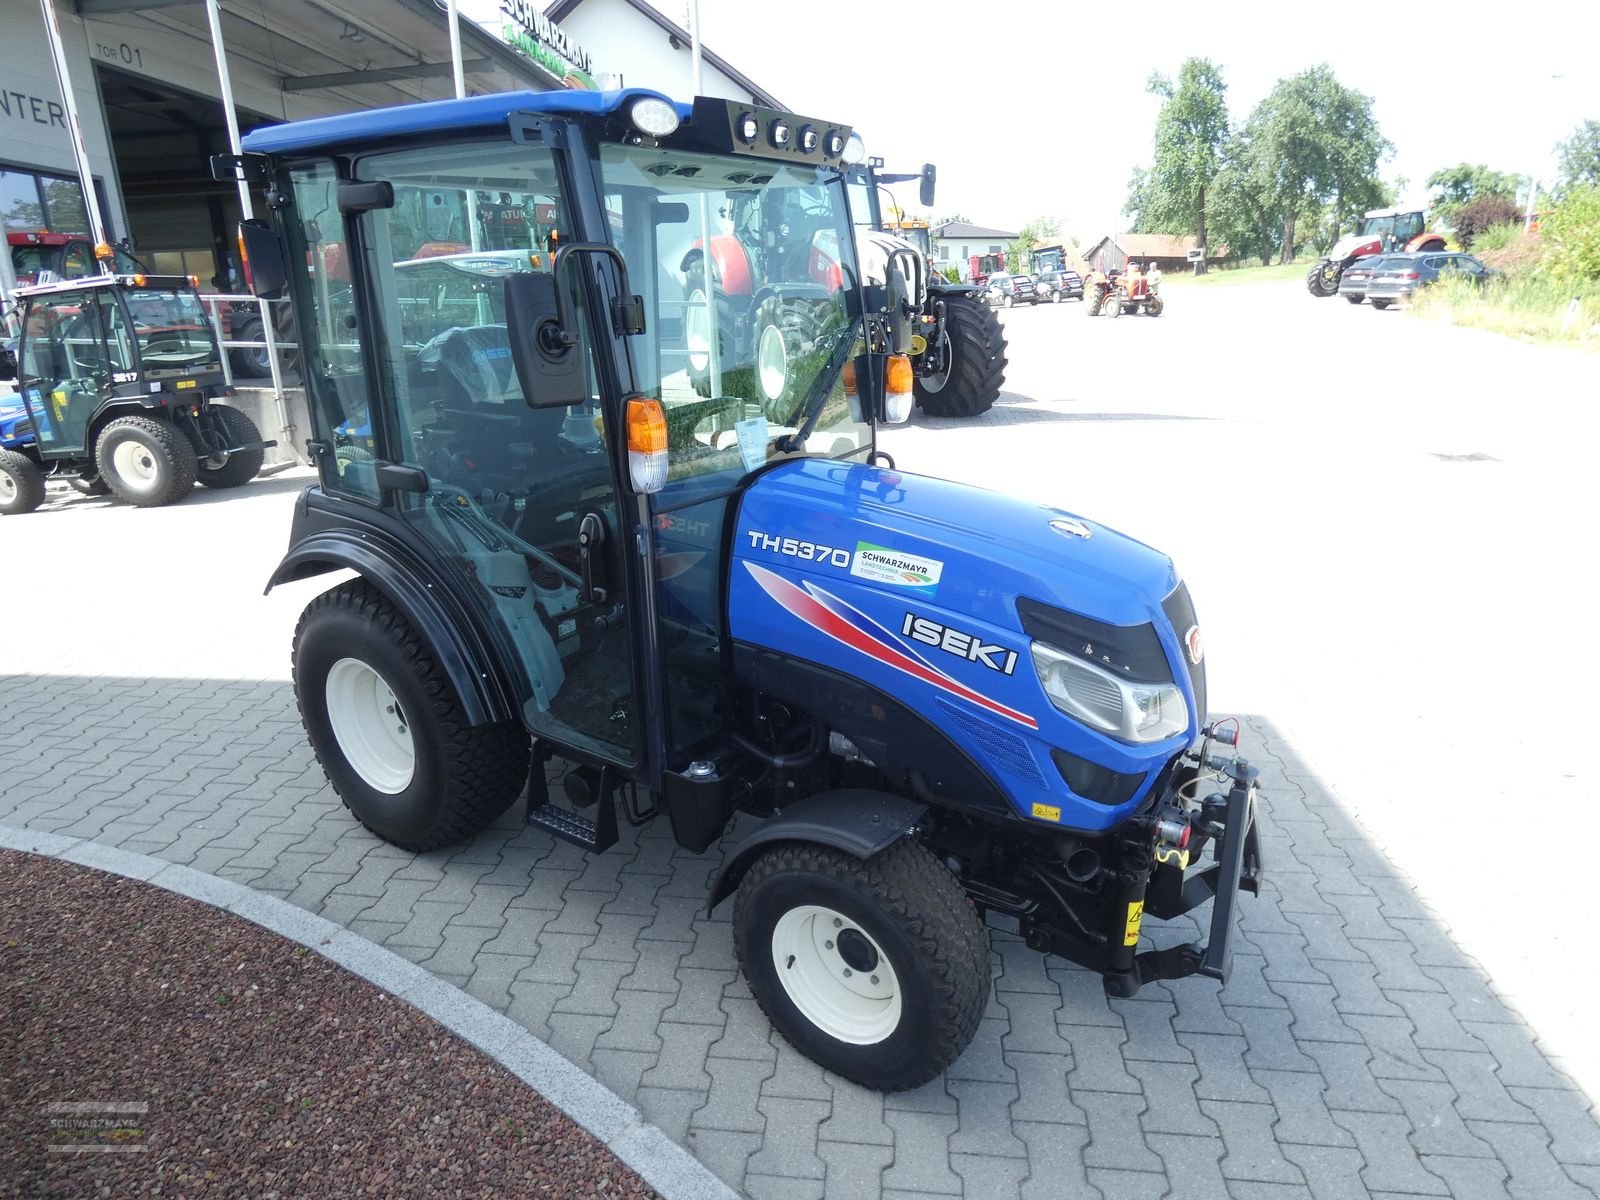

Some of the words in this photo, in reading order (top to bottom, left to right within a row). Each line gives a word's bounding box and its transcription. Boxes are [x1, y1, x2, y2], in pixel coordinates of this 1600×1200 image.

[95, 43, 118, 60] TOR
[120, 43, 143, 68] 01
[747, 529, 851, 569] TH5370
[861, 551, 928, 575] SCHWARZMAYR
[901, 611, 1019, 677] ISEKI
